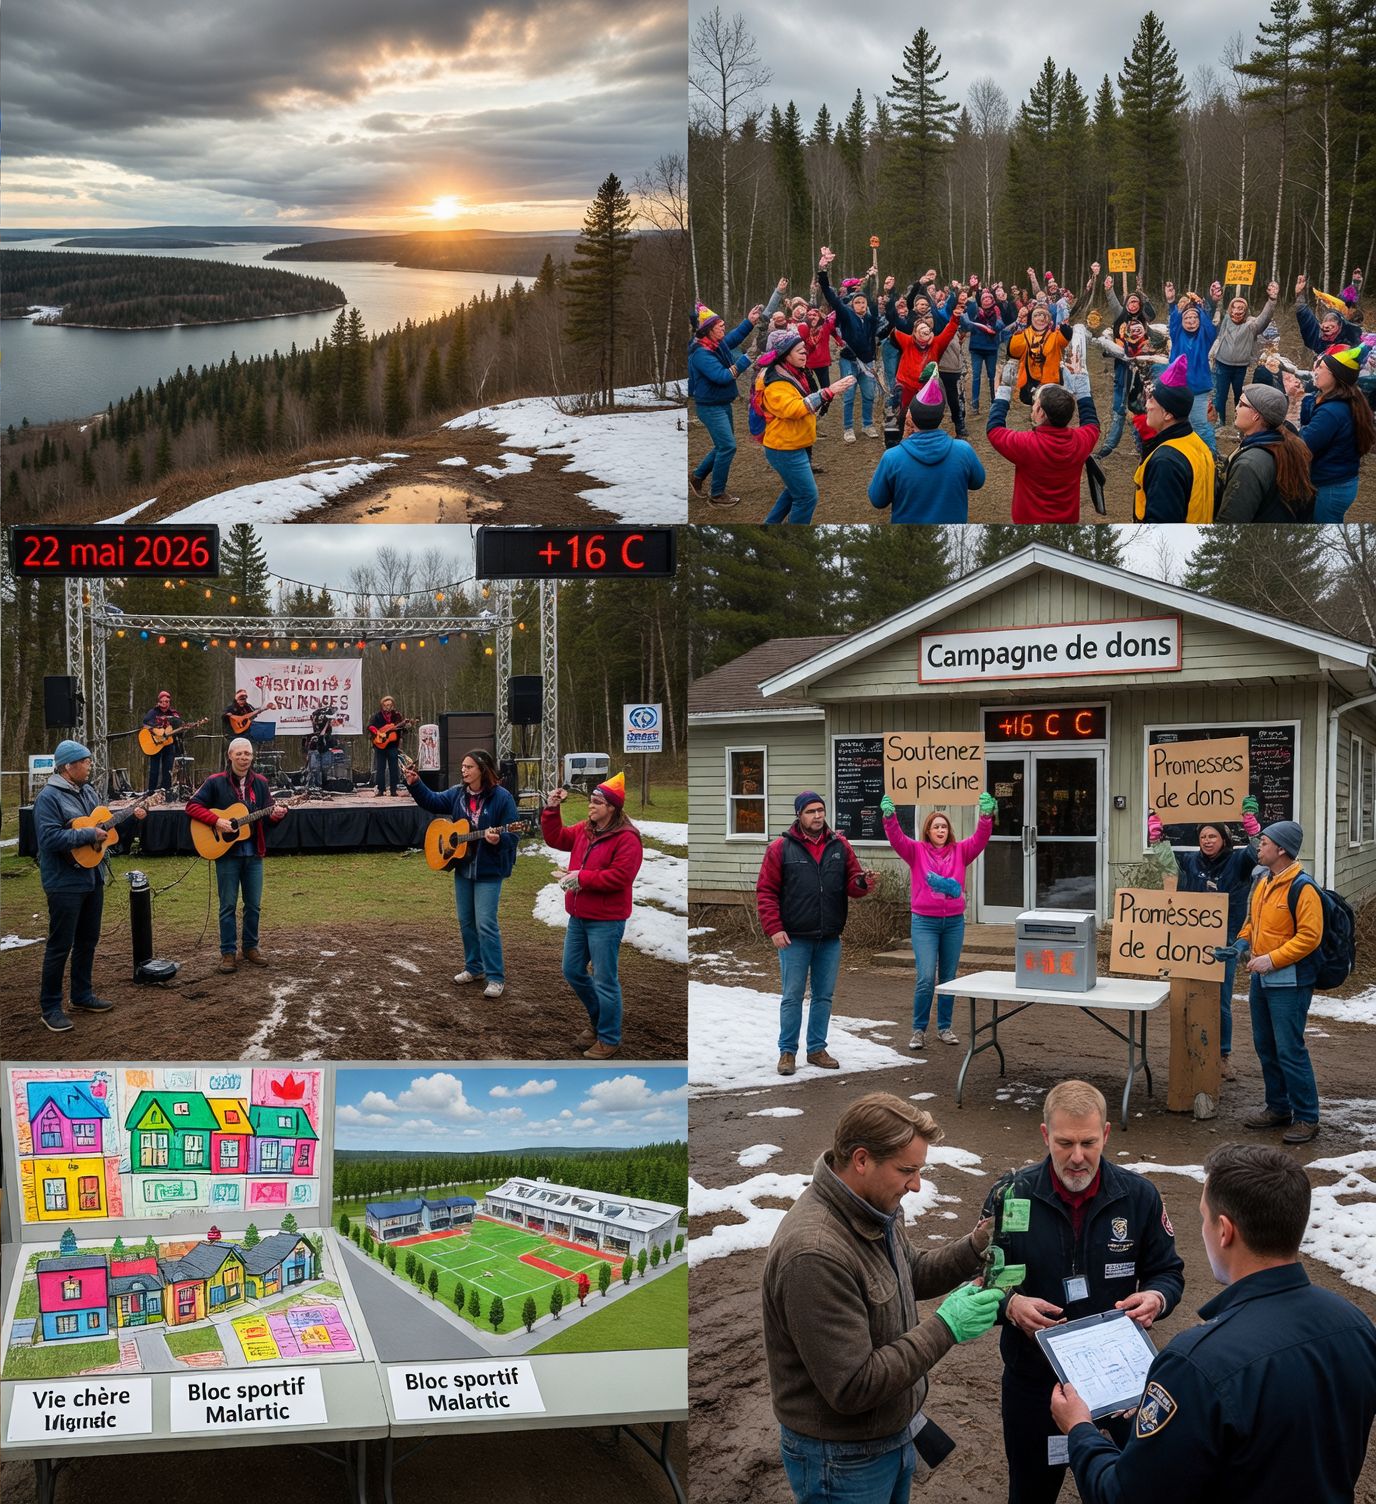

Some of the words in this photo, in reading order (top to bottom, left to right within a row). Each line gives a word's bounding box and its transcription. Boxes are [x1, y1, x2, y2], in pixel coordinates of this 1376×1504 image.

[24, 536, 60, 567] 22
[71, 536, 124, 567] mai
[134, 536, 209, 567] 2026
[538, 534, 607, 569] +16
[621, 534, 645, 569] C
[927, 643, 1057, 672] Campagne
[1065, 634, 1098, 660] de
[1105, 631, 1172, 658] dons
[999, 714, 1033, 737] +16
[1046, 714, 1059, 735] C
[1075, 711, 1092, 735] C
[886, 736, 982, 762] Soutenez
[1154, 748, 1244, 777] Promesses
[892, 766, 908, 790] la
[1155, 782, 1180, 809] de
[1186, 780, 1235, 806] dons
[1119, 930, 1146, 959] de
[1156, 931, 1217, 966] dons
[188, 1382, 231, 1401] Bloc
[237, 1376, 305, 1402] sportif
[405, 1372, 448, 1390] Bloc
[453, 1367, 519, 1391] sportif
[33, 1390, 66, 1409] Vie
[73, 1386, 130, 1407] chère
[428, 1391, 510, 1412] Malartic
[206, 1402, 290, 1423] Malartic
